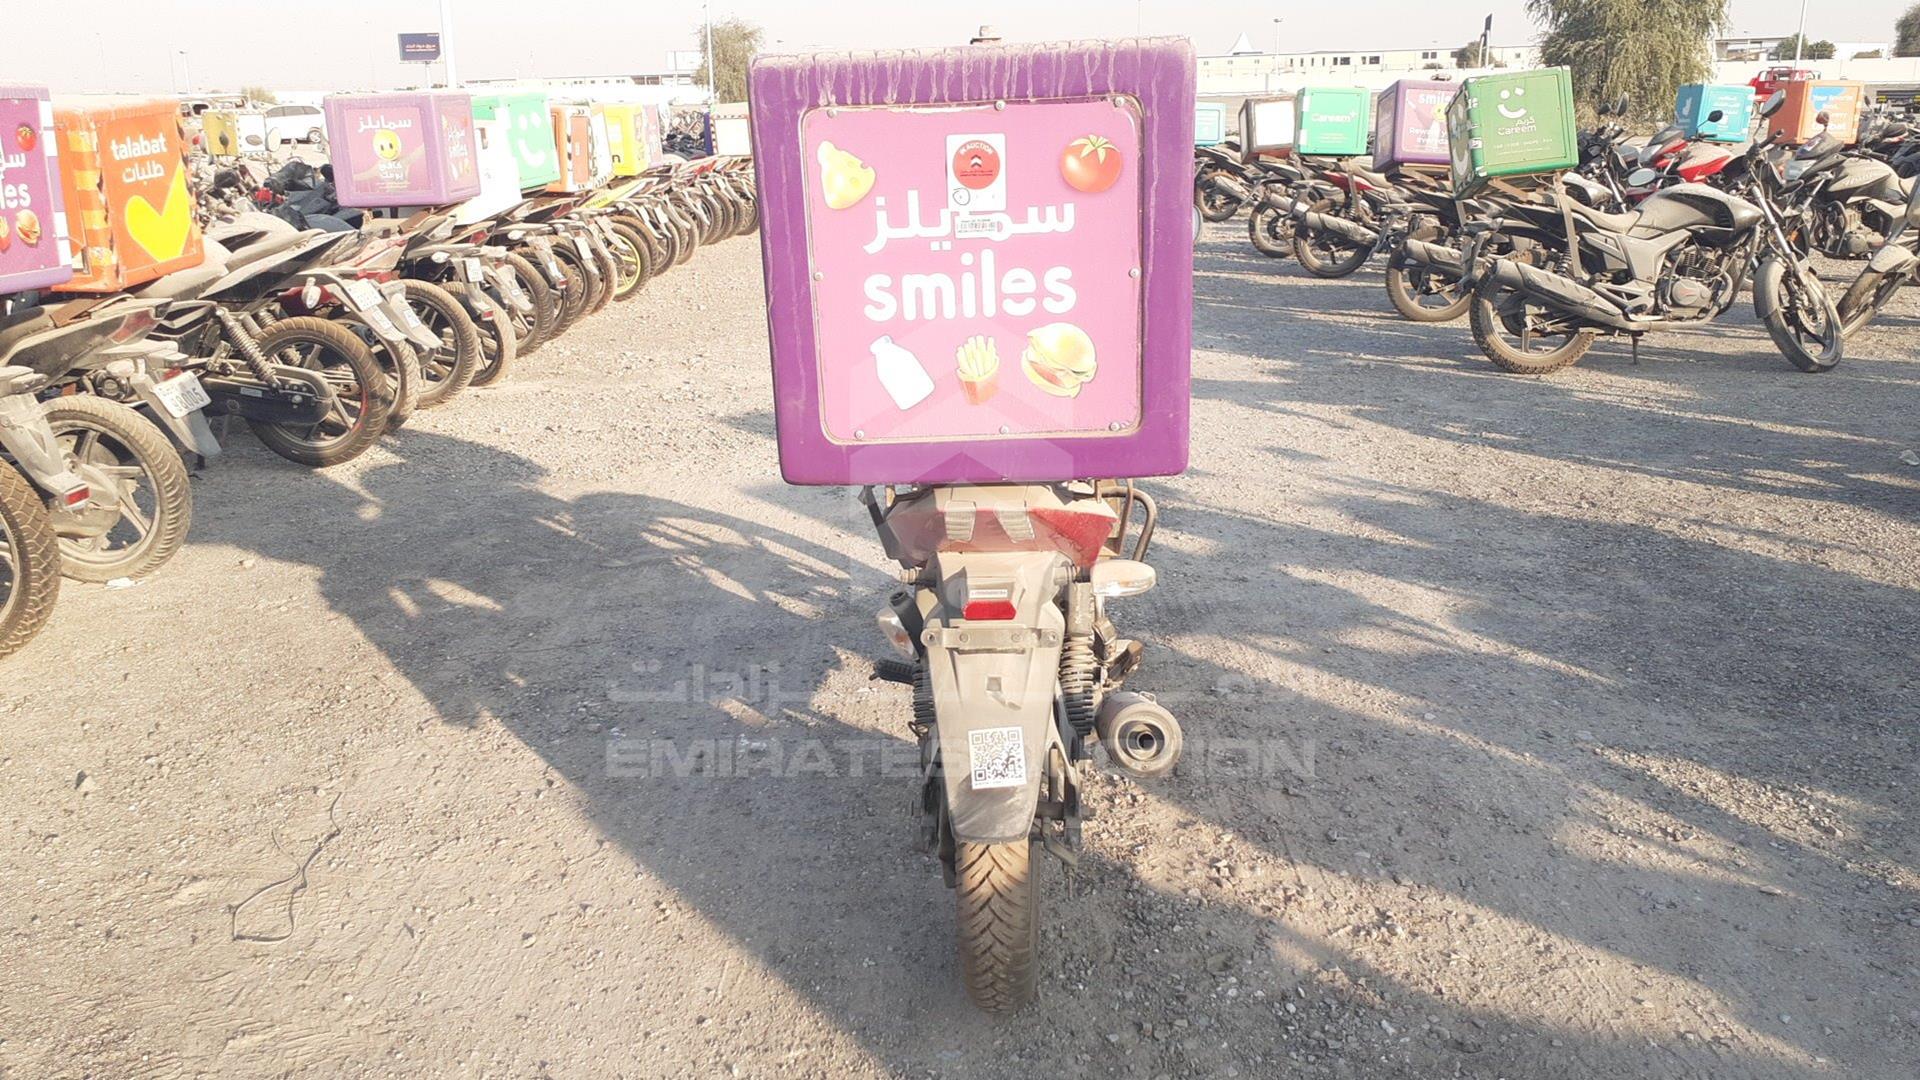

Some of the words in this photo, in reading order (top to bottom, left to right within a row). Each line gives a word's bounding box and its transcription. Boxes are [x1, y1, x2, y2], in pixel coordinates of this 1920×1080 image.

[1419, 91, 1452, 104] smile
[1497, 125, 1537, 136] Careem
[111, 132, 167, 160] talabat
[122, 160, 165, 186] طلبات
[863, 249, 1077, 322] smiles
